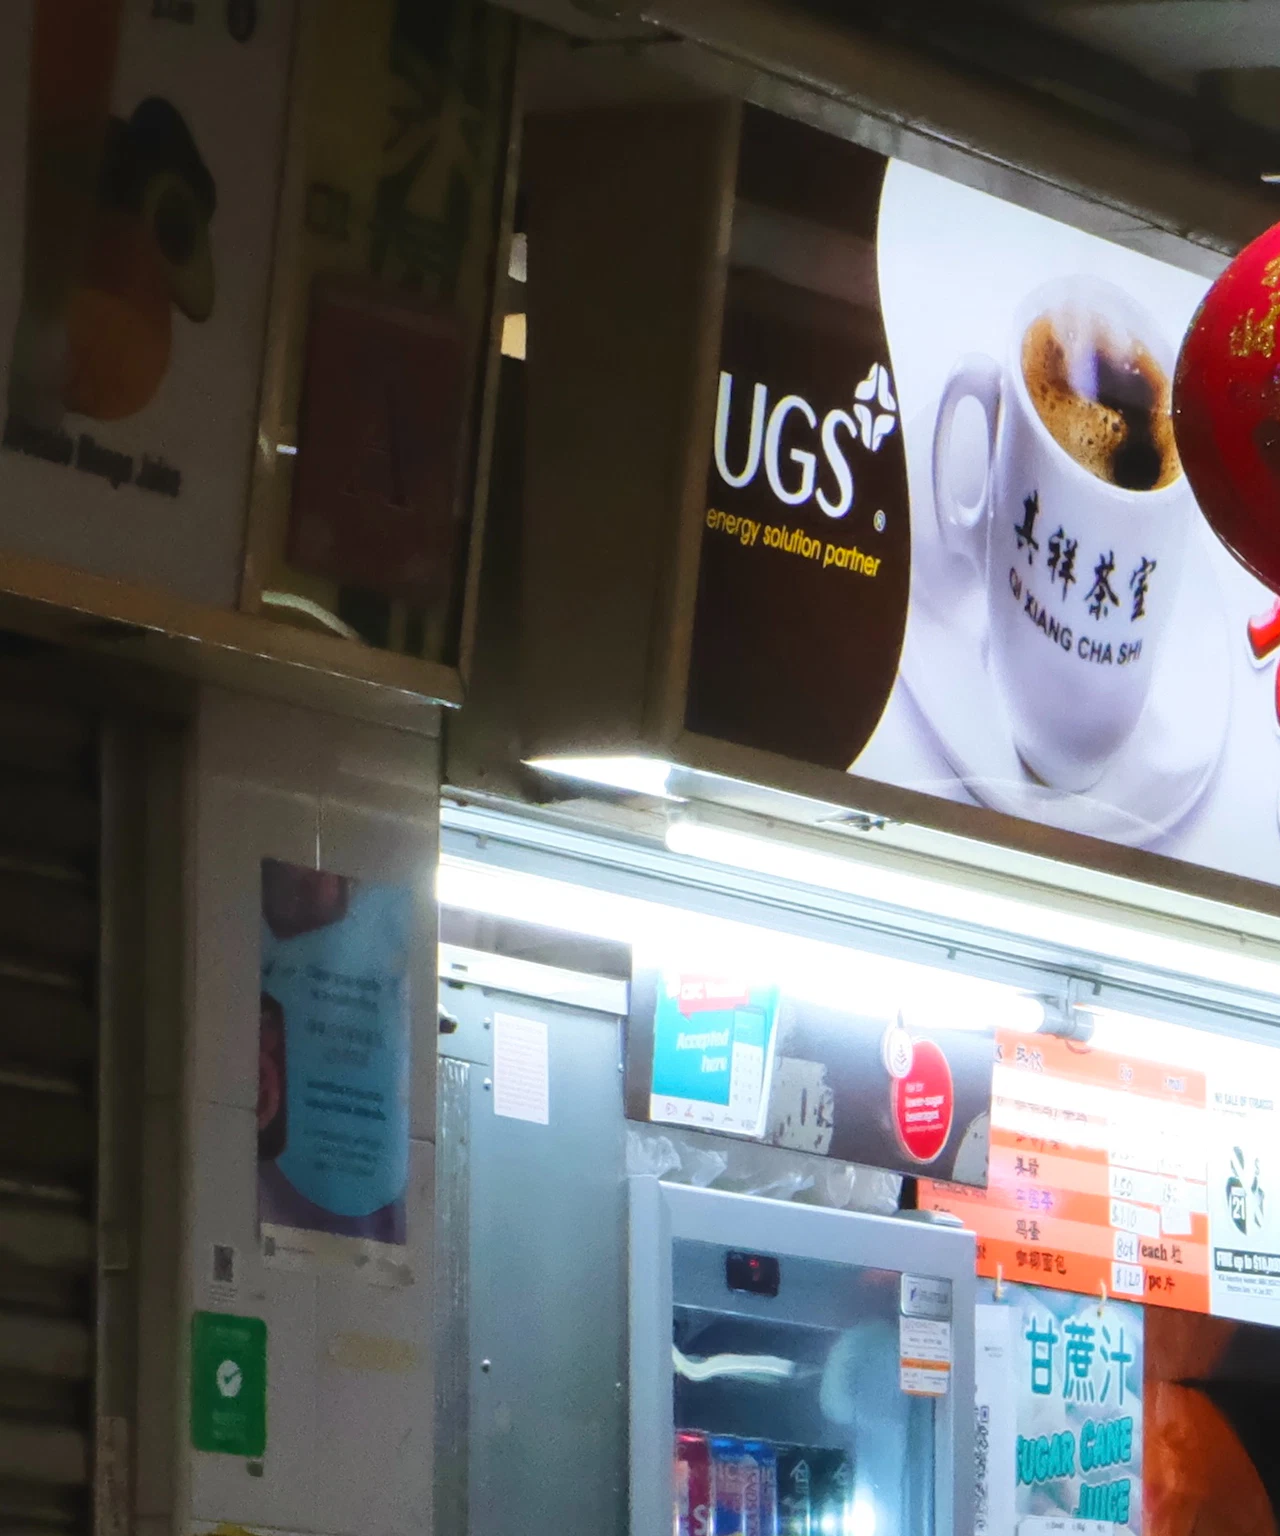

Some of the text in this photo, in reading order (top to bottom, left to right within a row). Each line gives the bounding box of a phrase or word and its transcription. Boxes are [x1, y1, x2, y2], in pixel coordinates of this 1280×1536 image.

[714, 370, 860, 519] UGS
[706, 508, 882, 577] energy solution partner
[1024, 588, 1073, 652] XIANG
[1077, 636, 1113, 665] CHA
[1117, 638, 1143, 666] SHI
[1025, 1313, 1133, 1407] 甘蔗汁
[1079, 1415, 1134, 1473] CANE
